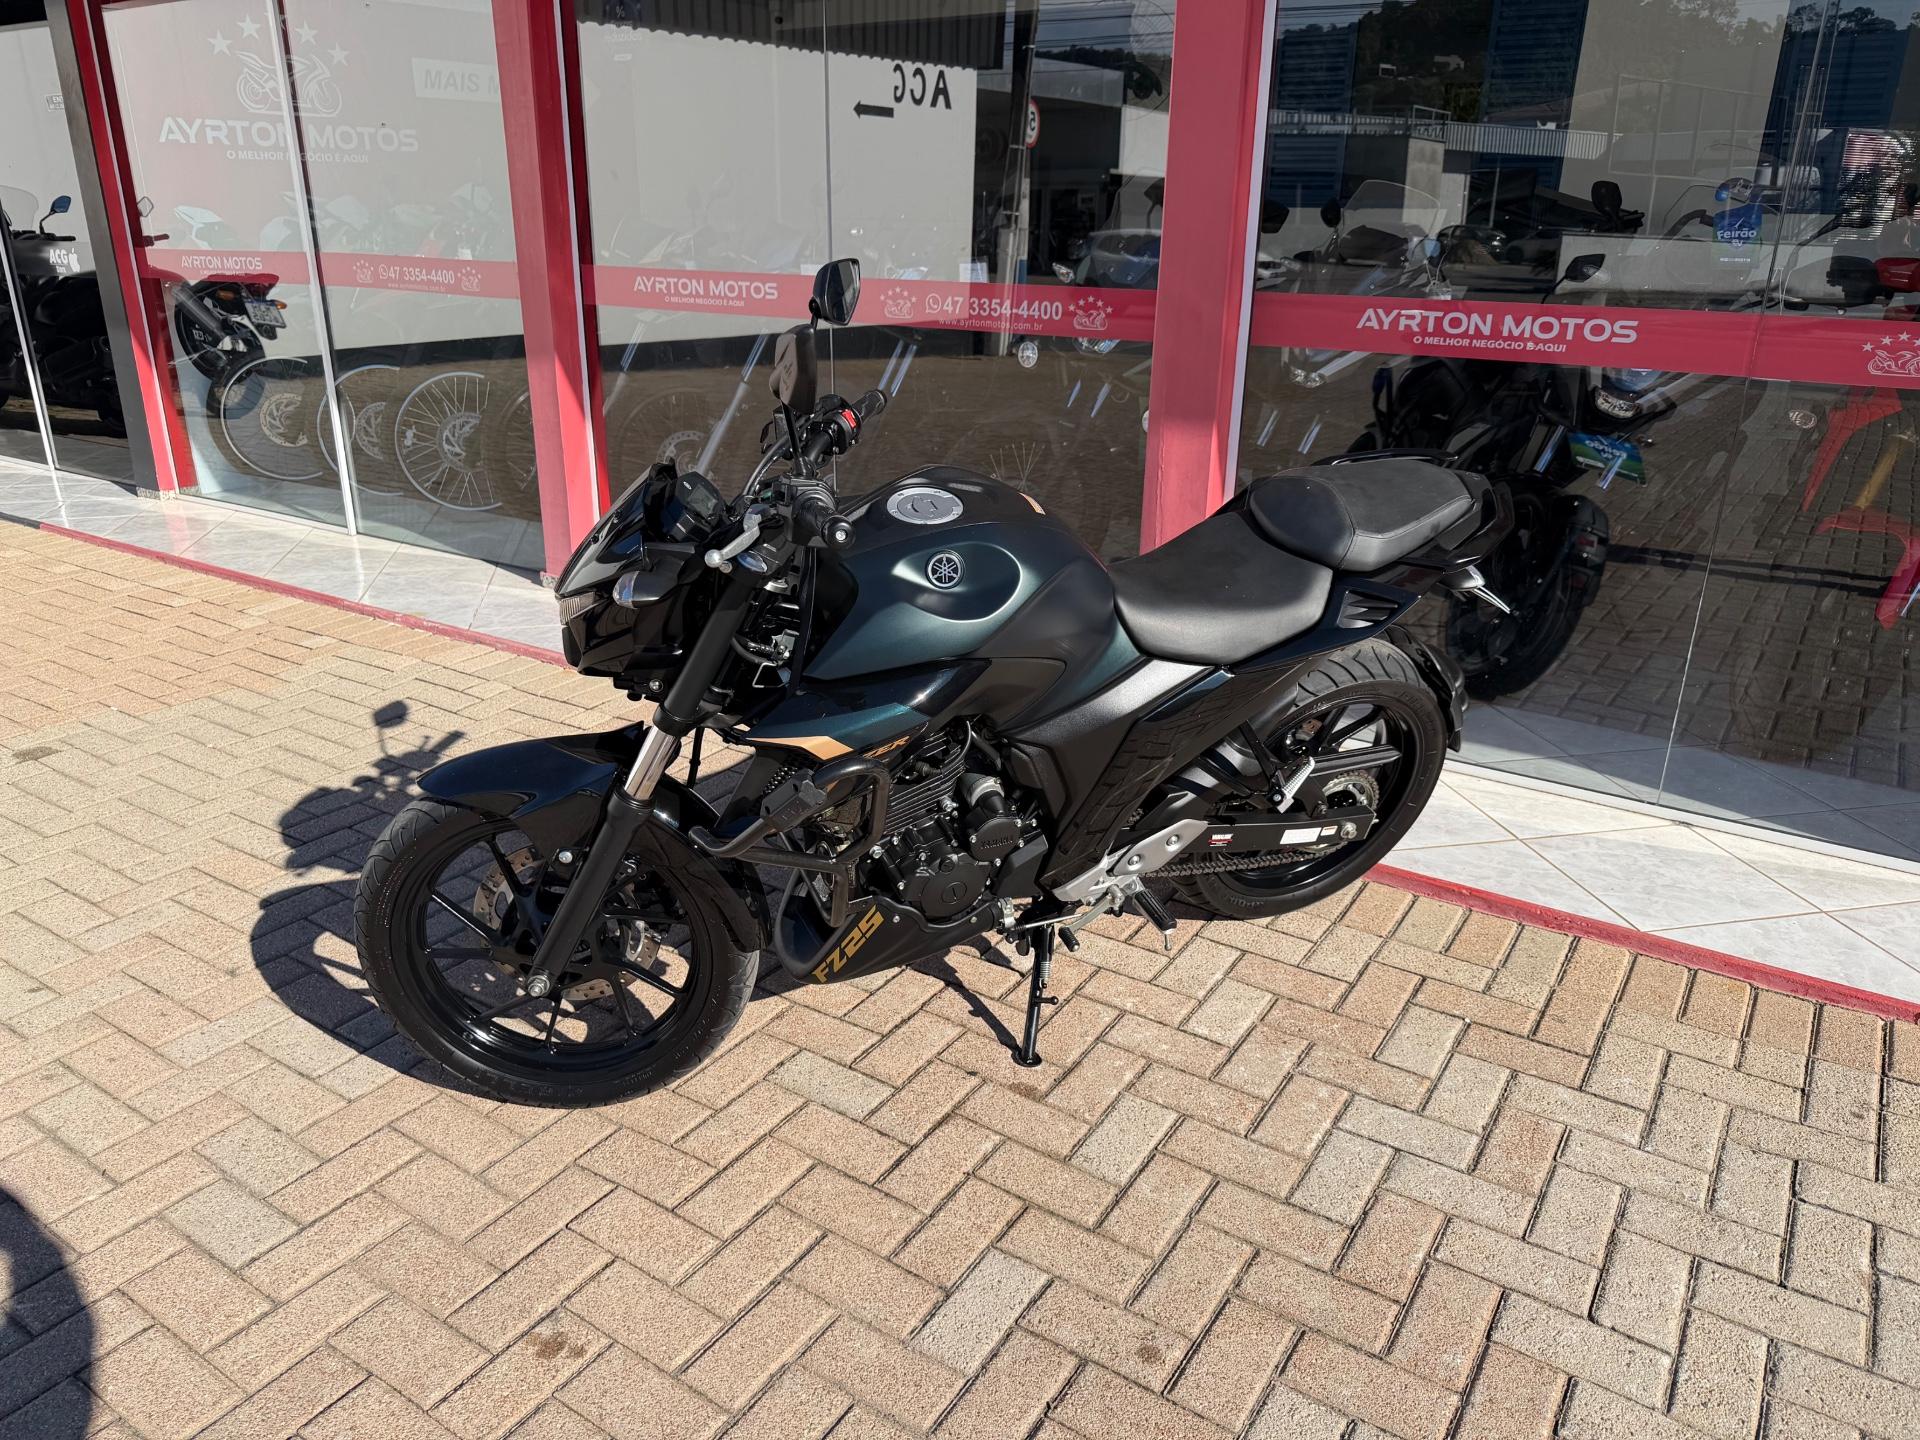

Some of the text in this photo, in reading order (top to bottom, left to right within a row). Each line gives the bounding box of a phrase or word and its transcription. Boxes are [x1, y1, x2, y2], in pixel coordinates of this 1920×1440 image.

[424, 69, 479, 92] MAIS
[307, 124, 419, 151] MOTOS
[226, 151, 236, 159] O
[238, 151, 283, 160] MELHOR
[1716, 228, 1757, 240] Feirão
[49, 249, 68, 264] ACG
[181, 255, 262, 270] AYRTON MOTOS
[388, 265, 455, 284] 47 3354-4400
[633, 276, 778, 299] AYRTON MOTOS
[942, 296, 1063, 320] 47 3354-4400
[938, 318, 1043, 331] www.ayrtonmotos.com.br
[1356, 308, 1639, 344] AYRTON MOTOS
[1413, 335, 1422, 344] O
[1424, 336, 1470, 347] MELHOR
[1535, 343, 1567, 353] AQUI
[862, 735, 911, 759] ZER
[811, 904, 885, 983] FZ25
